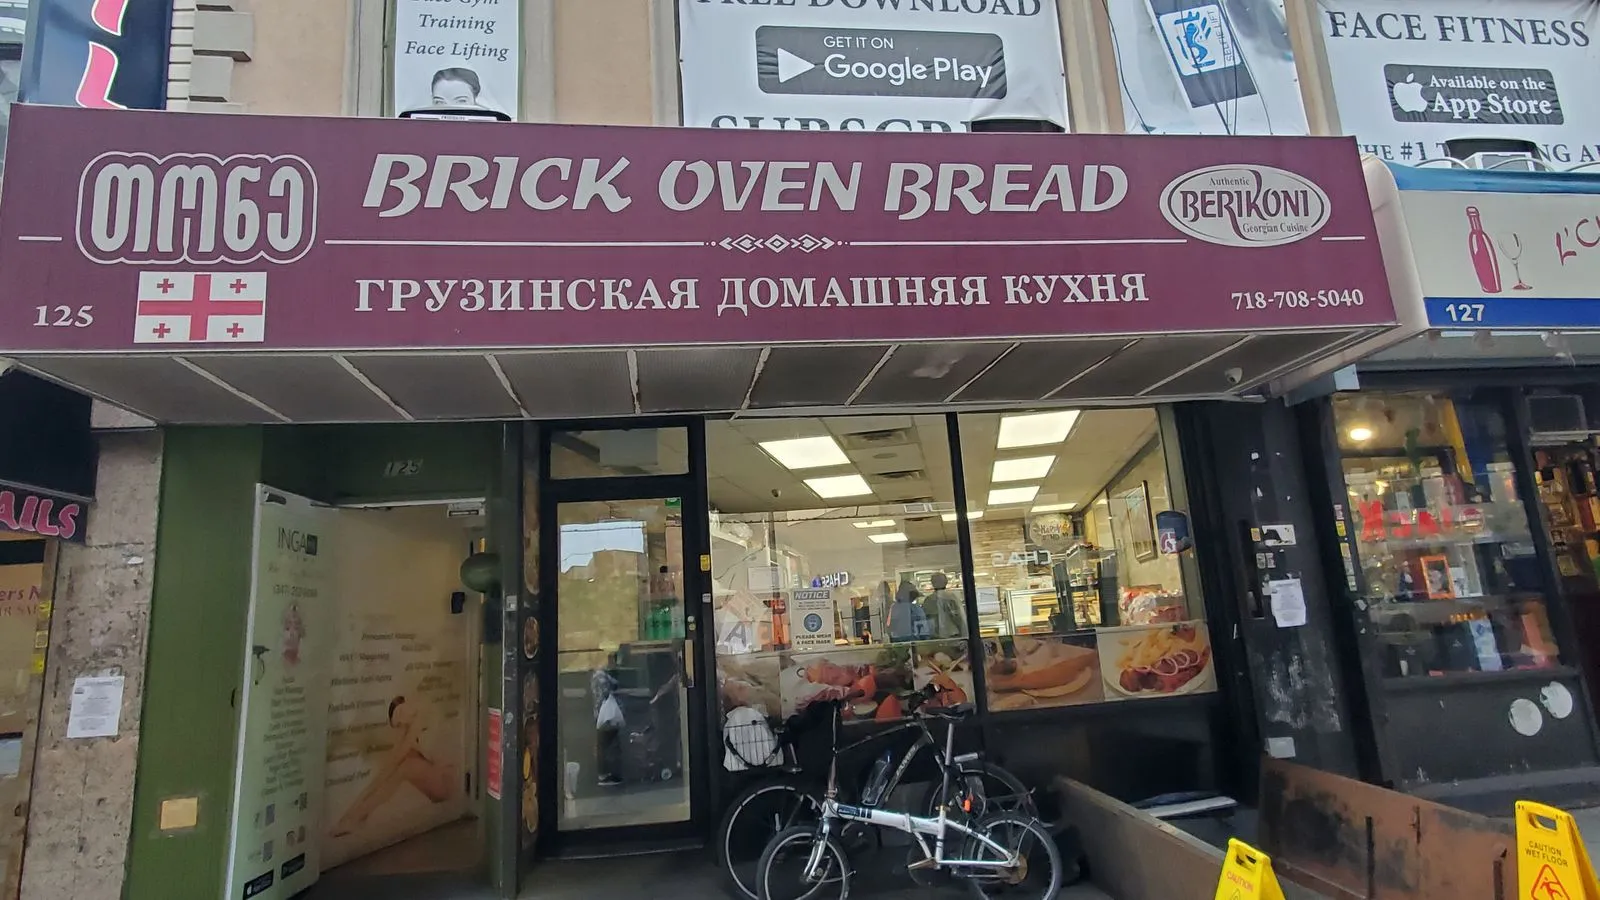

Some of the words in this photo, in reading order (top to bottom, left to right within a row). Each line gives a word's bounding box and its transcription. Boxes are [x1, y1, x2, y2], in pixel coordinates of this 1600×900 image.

[419, 14, 496, 34] Training
[1325, 11, 1427, 41] FACE
[1434, 16, 1590, 47] FITNESS
[405, 41, 445, 55] Face
[450, 43, 509, 61] Lifting
[823, 36, 852, 49] GET
[856, 37, 868, 49] IT
[871, 37, 894, 50] ON
[824, 54, 928, 86] Google
[934, 58, 992, 88] Play
[1429, 75, 1496, 89] Available
[1500, 80, 1519, 89] on
[1522, 77, 1546, 90] the
[1432, 92, 1480, 119] App
[1488, 93, 1553, 114] Store
[1358, 144, 1394, 160] HE
[1400, 141, 1427, 160] #1
[362, 154, 632, 218] BRICK
[658, 160, 862, 211] OVEN
[883, 162, 1128, 220] BREAD
[1209, 177, 1250, 186] Authentic
[1180, 180, 1310, 234] BERIKONI
[1242, 223, 1278, 235] Georgian
[1280, 222, 1309, 233] Cuisine
[355, 279, 699, 312] ГРУЗИНСКАЯ
[717, 277, 990, 317] ДОМАШНЯЯ
[1001, 274, 1150, 304] КУХНЯ
[1231, 288, 1364, 310] 718-708-5040
[34, 305, 94, 328] 125
[1445, 303, 1485, 322] 127
[795, 591, 829, 600] NOTICE
[1525, 847, 1540, 858] WET
[1542, 852, 1569, 868] FLOOR
[1528, 841, 1562, 857] CAUTION
